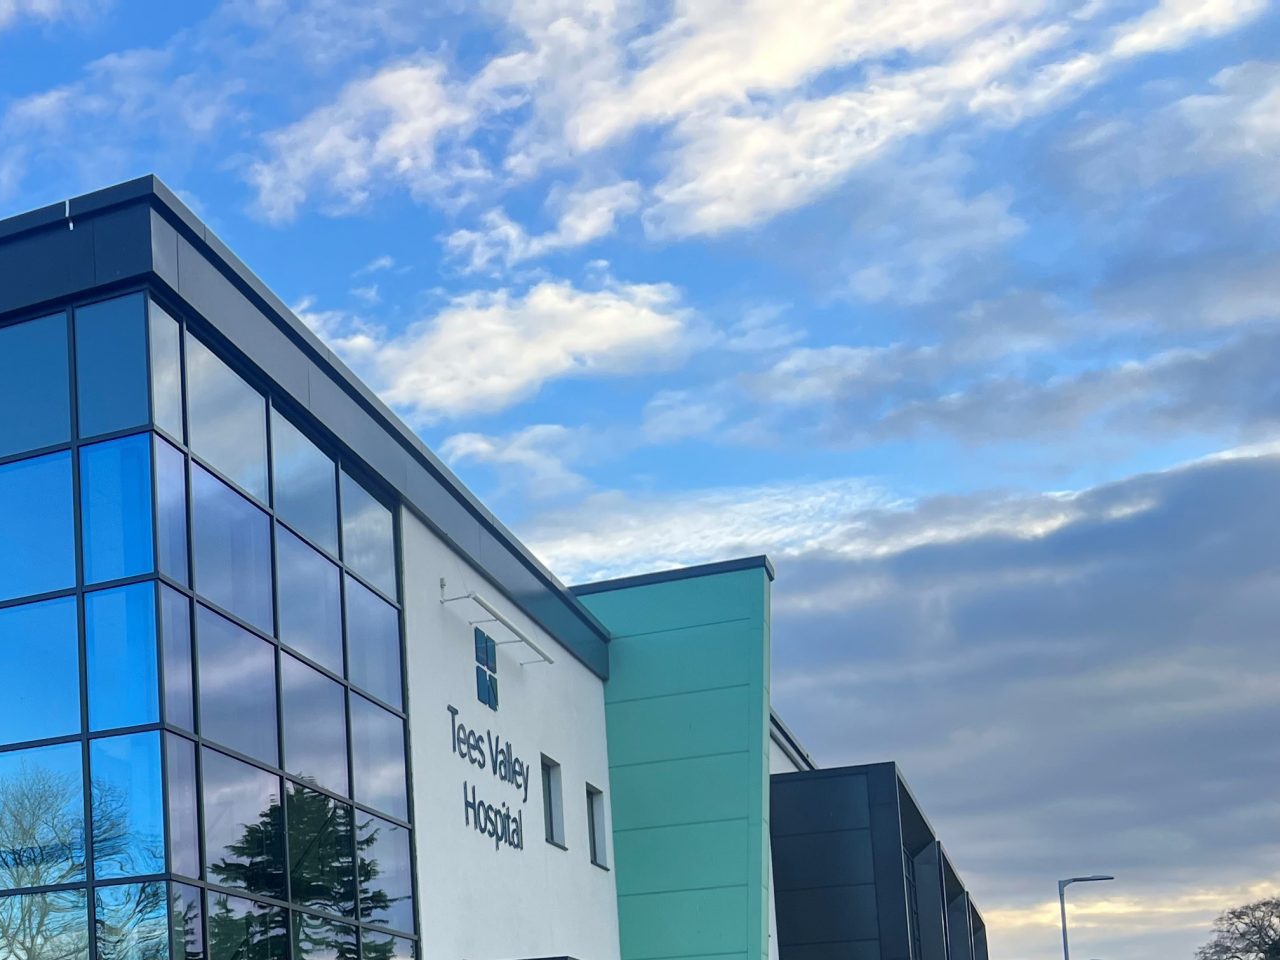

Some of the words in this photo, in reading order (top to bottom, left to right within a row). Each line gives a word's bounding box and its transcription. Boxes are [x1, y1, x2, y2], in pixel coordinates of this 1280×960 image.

[447, 704, 486, 770] Tees
[486, 729, 529, 803] Valley
[463, 780, 523, 851] Hospital
